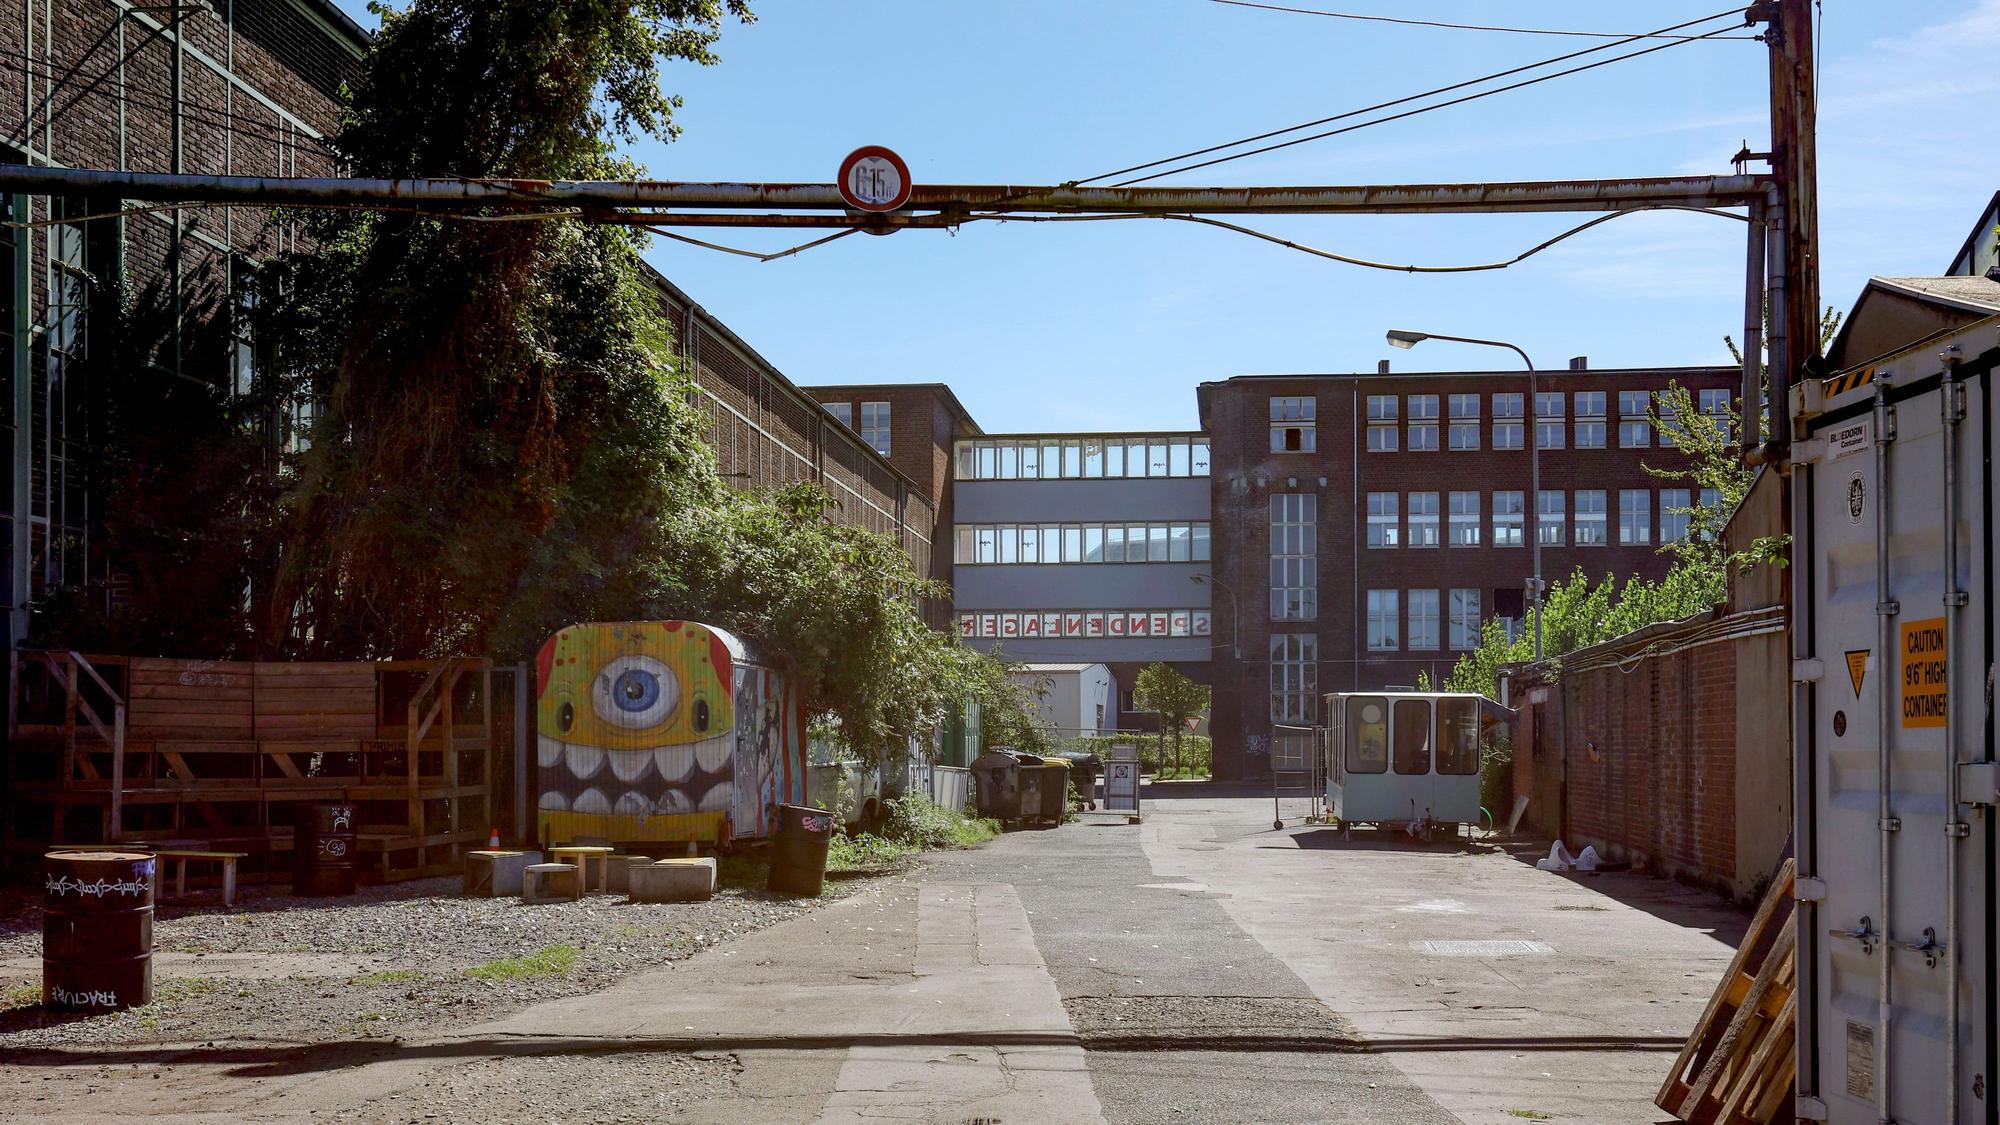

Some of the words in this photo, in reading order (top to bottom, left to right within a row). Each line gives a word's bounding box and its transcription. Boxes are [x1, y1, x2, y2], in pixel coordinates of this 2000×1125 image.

[1908, 628, 1943, 653] CAUTION
[1925, 660, 1947, 685] HIGH
[51, 984, 118, 1008] FRACTURE
